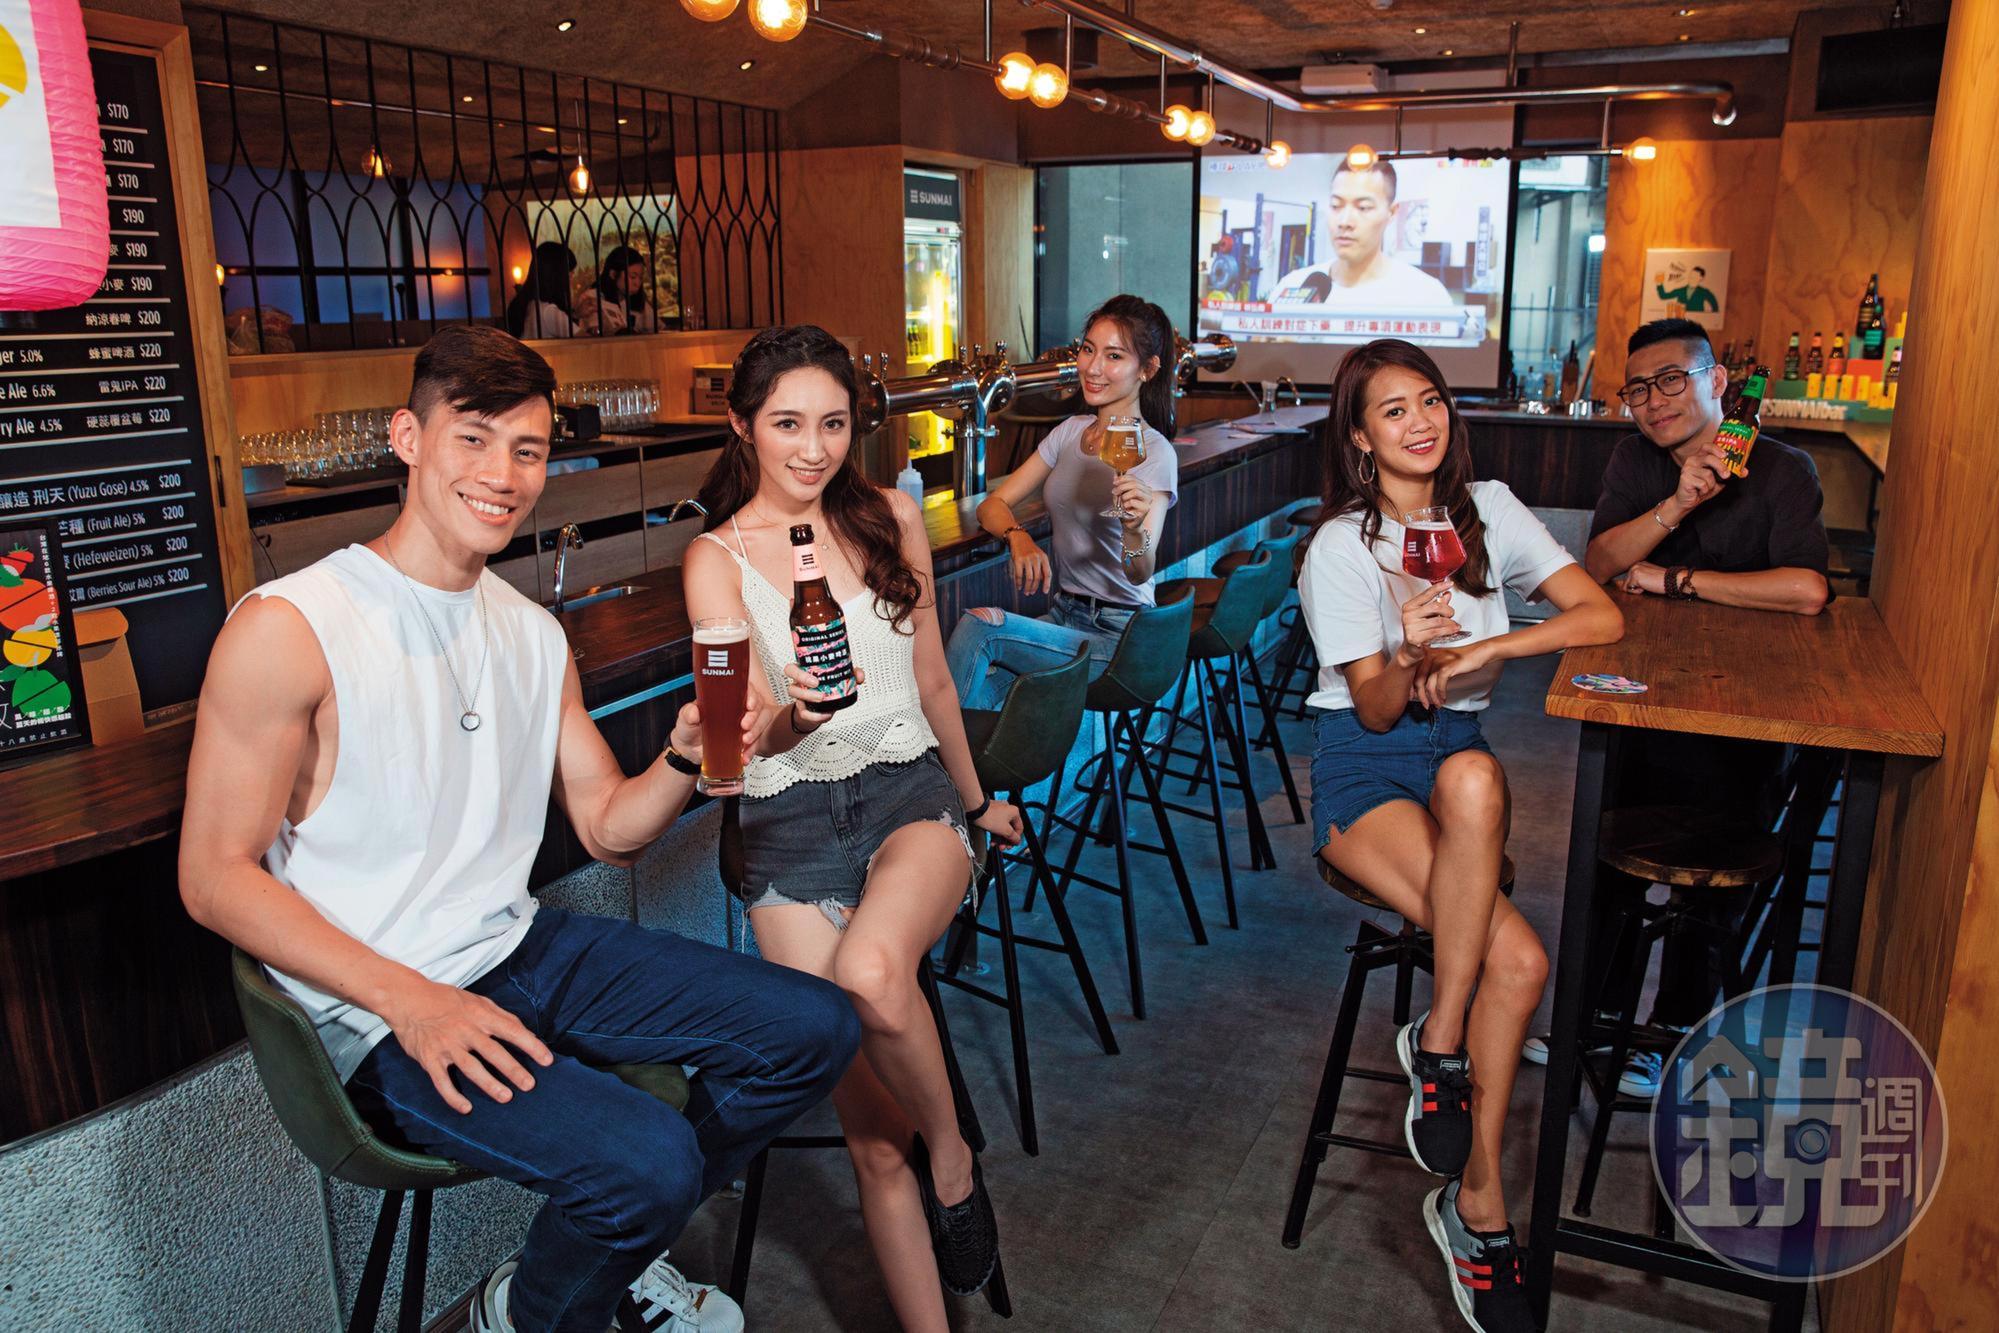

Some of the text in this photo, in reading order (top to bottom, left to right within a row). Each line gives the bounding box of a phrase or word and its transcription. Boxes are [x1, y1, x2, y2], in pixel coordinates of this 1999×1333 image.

[107, 103, 129, 120] $170
[113, 138, 135, 155] $170
[118, 173, 139, 190] $170
[919, 191, 953, 206] SUNMAI
[122, 208, 145, 224] $190
[126, 242, 148, 258] $190
[131, 276, 153, 291] $190
[137, 310, 161, 325] $200
[19, 349, 44, 364] 5.0%
[88, 346, 135, 360] 蜂蜜啤酒
[139, 343, 162, 358] $220
[8, 383, 28, 400] Ale
[32, 384, 56, 398] 6.6%
[144, 376, 166, 391] $220
[16, 418, 35, 434] Ale
[39, 419, 63, 433] 4.5%
[149, 408, 171, 424] $220
[33, 487, 66, 505] 刑天
[68, 486, 97, 502] (Yuzu
[99, 480, 128, 496] Gose)
[129, 480, 150, 493] 4.5%
[159, 473, 181, 488] $200
[87, 517, 112, 533] (Fruit
[113, 514, 132, 530] Ale)
[132, 513, 146, 526] 5%
[162, 505, 184, 520] $200
[73, 545, 139, 569] (Hefeweizen)
[141, 544, 154, 557] 5%
[166, 536, 188, 551] $200
[87, 583, 118, 600] (Berries
[118, 579, 136, 593] Sour
[137, 577, 152, 590] Ale)
[153, 575, 165, 587] 5%
[168, 567, 190, 582] $200
[702, 668, 735, 676] SUNMAI
